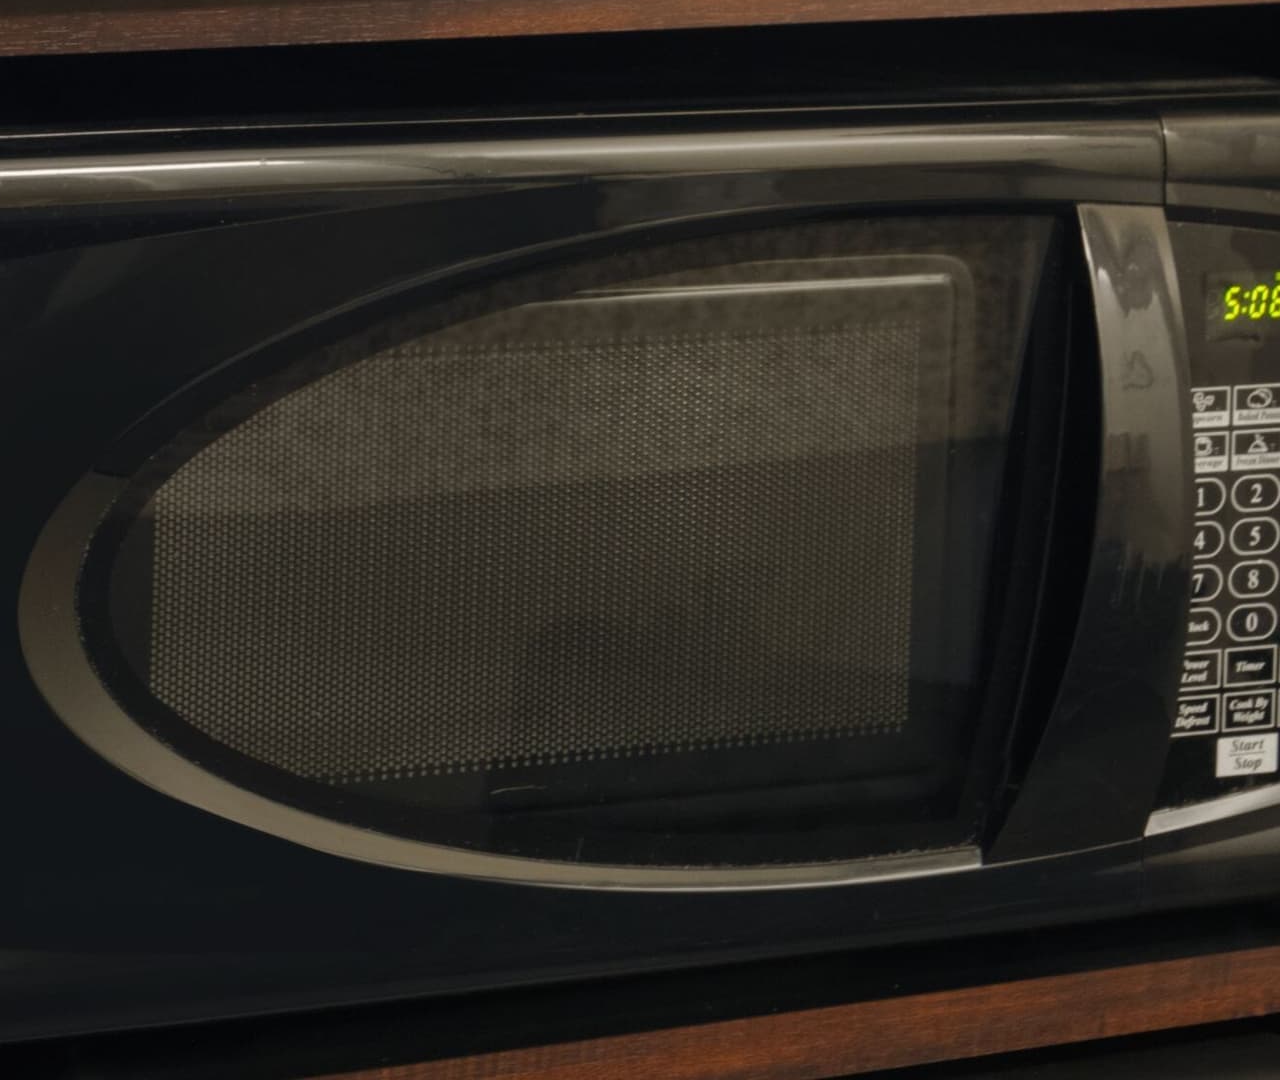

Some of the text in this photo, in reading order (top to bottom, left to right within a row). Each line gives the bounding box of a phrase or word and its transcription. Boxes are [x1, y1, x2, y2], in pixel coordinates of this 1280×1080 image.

[1197, 488, 1204, 507] 1
[1250, 483, 1263, 503] 2
[1194, 530, 1205, 550] 4
[1248, 526, 1261, 546] 5
[1192, 573, 1204, 593] 7
[1247, 569, 1260, 589] 8
[1245, 612, 1258, 632] 0
[1236, 661, 1266, 672] Timer
[1181, 671, 1208, 684] Level
[1229, 697, 1269, 710] Cook By
[1231, 739, 1265, 752] Start
[1233, 758, 1263, 770] Stop
